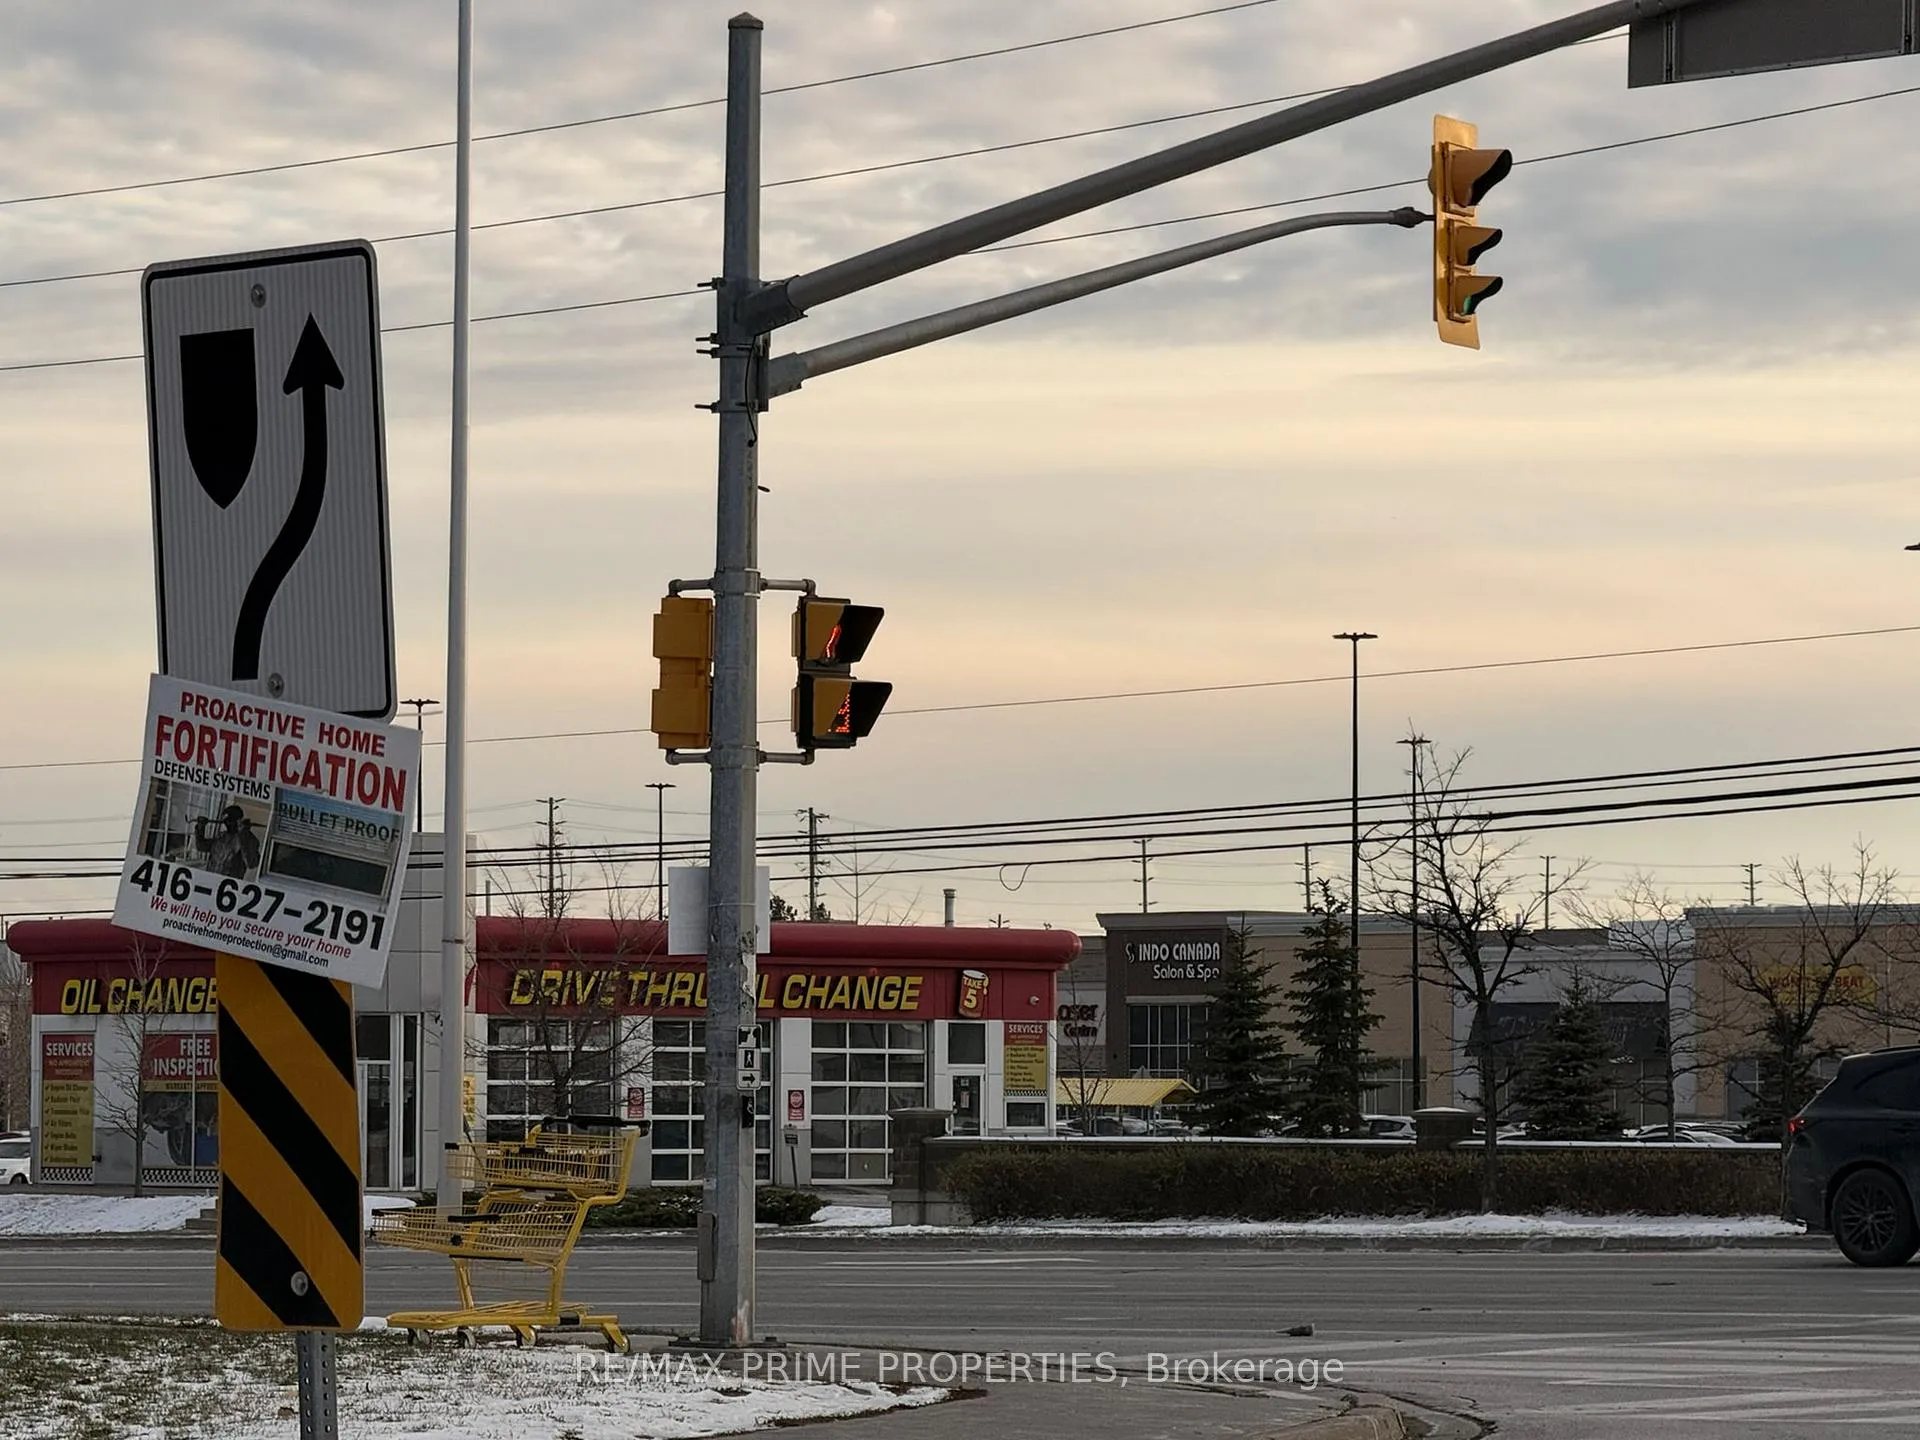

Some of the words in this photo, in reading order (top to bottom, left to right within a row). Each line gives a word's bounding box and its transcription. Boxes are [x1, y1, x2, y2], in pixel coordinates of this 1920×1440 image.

[180, 691, 305, 740] PROACTIVE
[318, 722, 386, 757] HOME
[154, 715, 407, 812] FORTIFICATION
[154, 759, 210, 786] DEFENSE
[212, 768, 272, 799] SYSTEMS
[278, 802, 340, 831] BULLET
[345, 816, 401, 843] PROOF
[130, 859, 386, 950] 416-627-2191
[150, 896, 168, 912] We
[170, 903, 190, 922] will
[192, 909, 217, 926] help
[219, 916, 241, 932] you
[244, 924, 284, 941] secure
[287, 931, 315, 949] your
[315, 938, 352, 959] home
[162, 917, 329, 968] proactivehomeprotection@gmail.com
[1139, 943, 1169, 961] INDO
[1172, 942, 1220, 961] CANADA
[509, 969, 621, 1007] DRIVE
[782, 974, 923, 1010] CHANGE
[963, 976, 983, 990] TAKE
[1153, 964, 1184, 979] Salon
[1185, 963, 1195, 978] &
[60, 978, 101, 1014] OIL
[107, 977, 217, 1014] CHANGE
[963, 988, 978, 1009] 5
[180, 1038, 211, 1056] FREE
[1008, 1024, 1044, 1034] SERVICES
[45, 1042, 94, 1057] SERVICES
